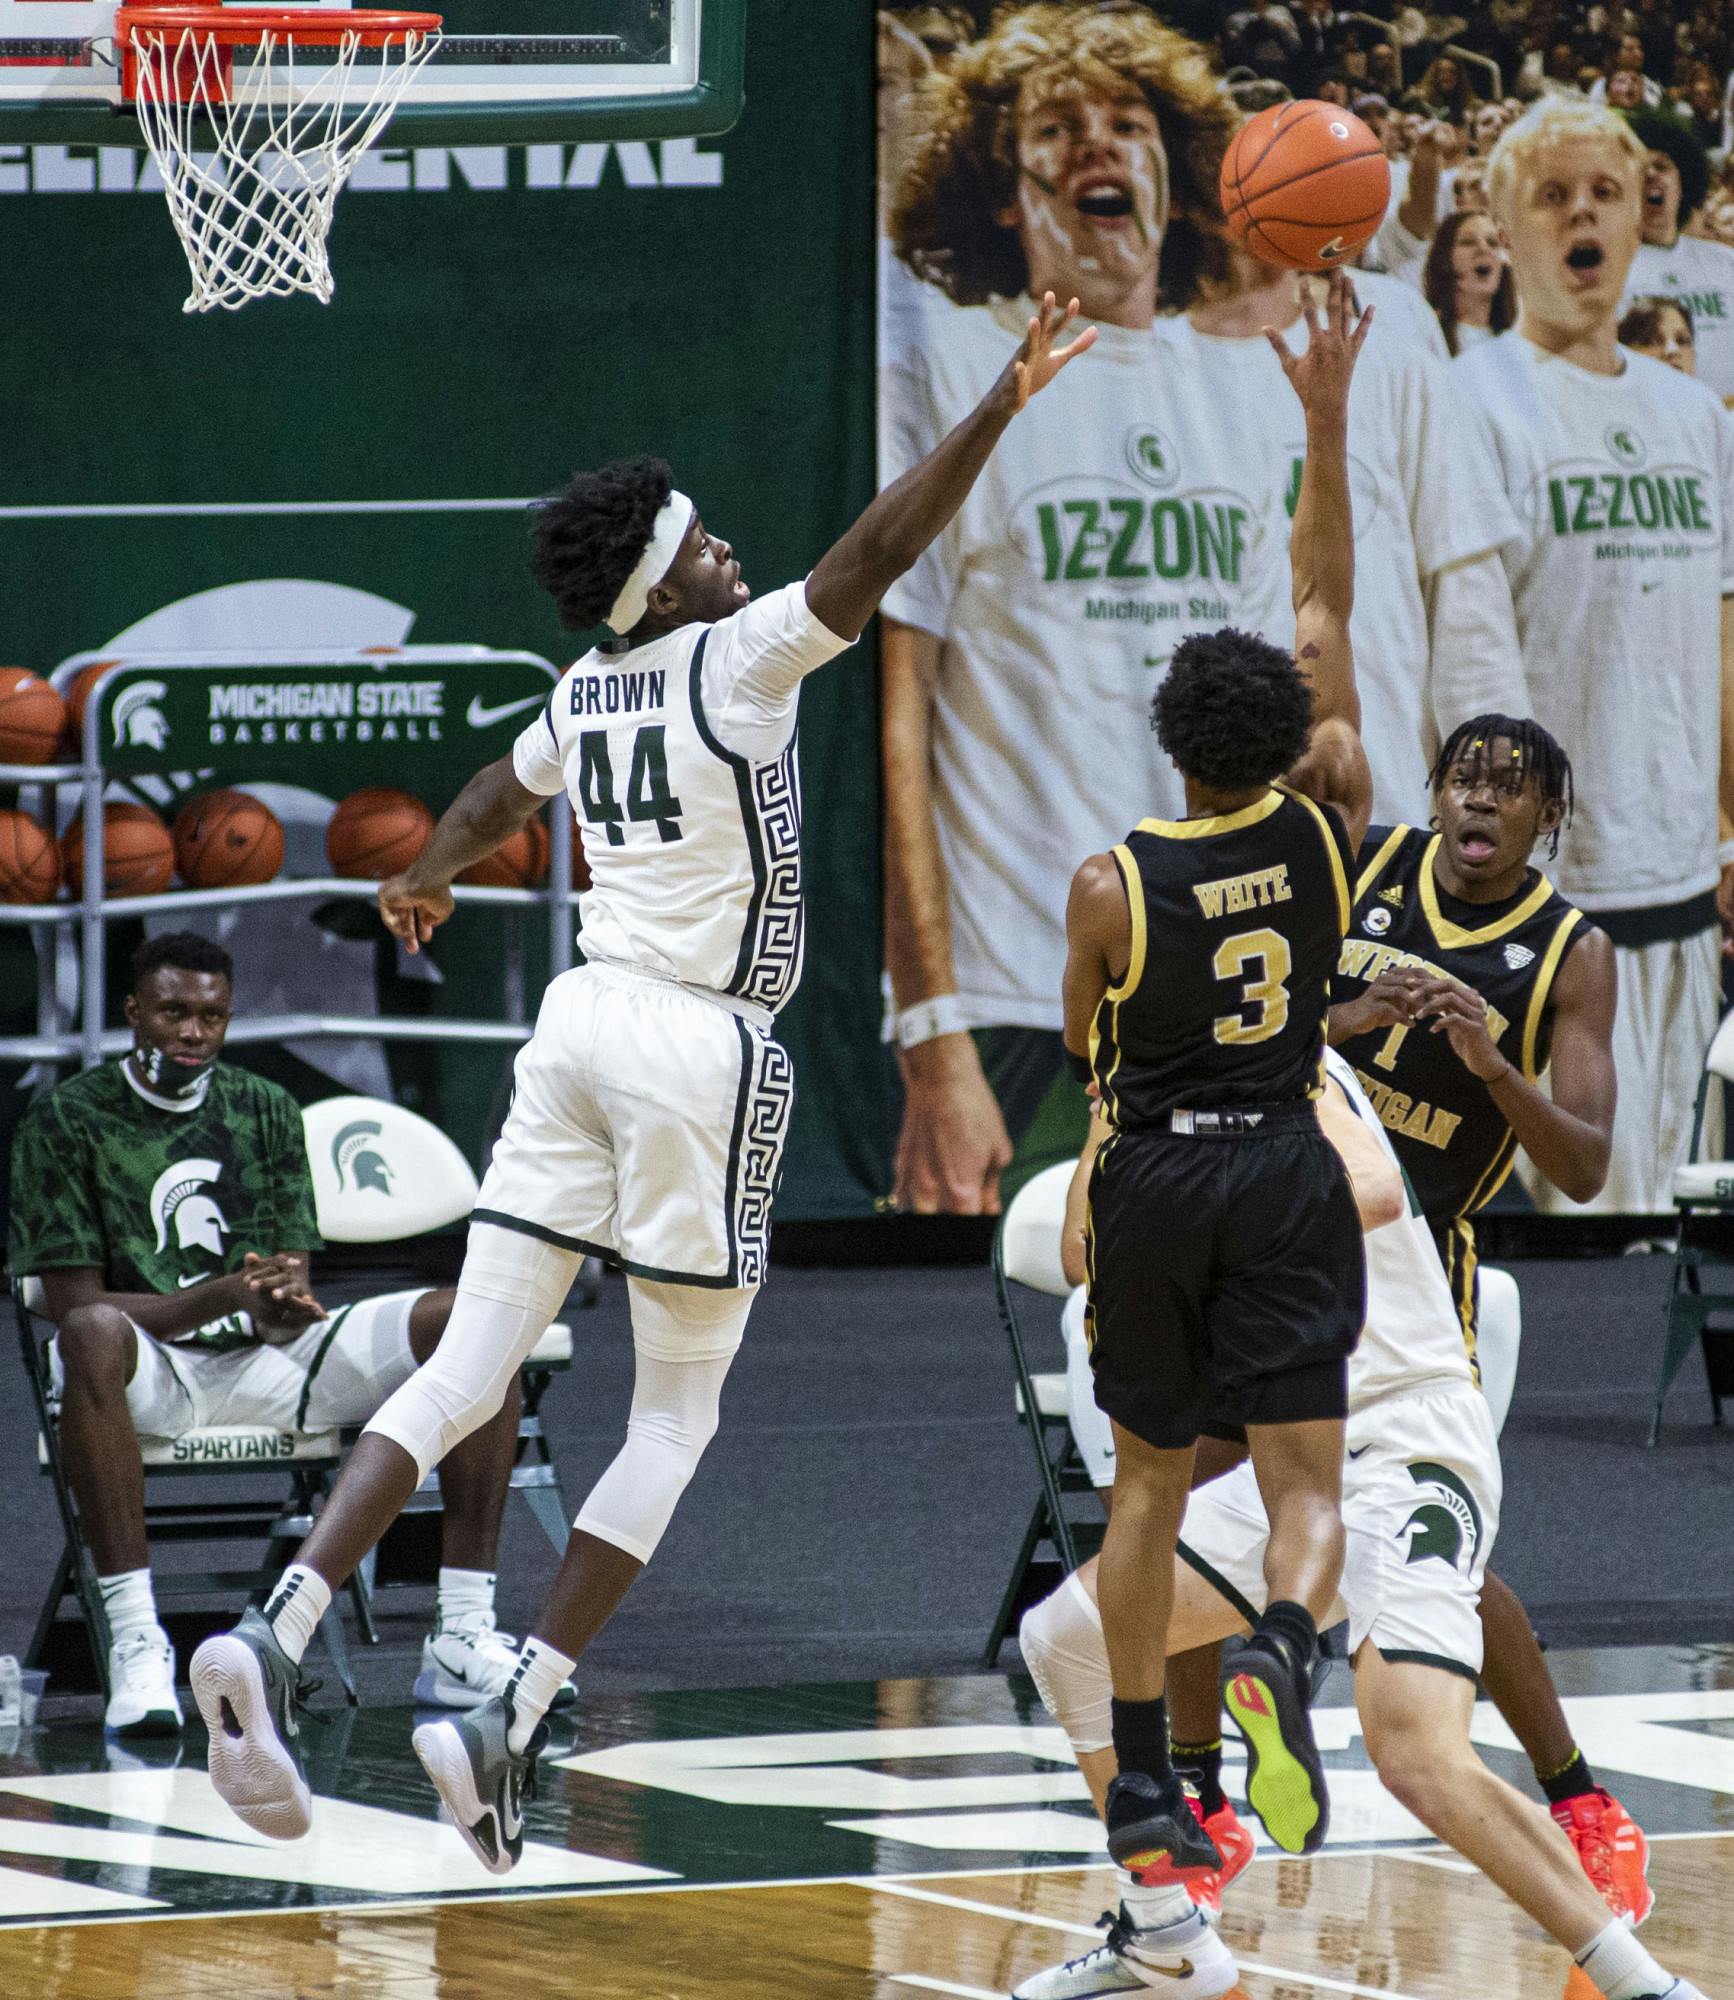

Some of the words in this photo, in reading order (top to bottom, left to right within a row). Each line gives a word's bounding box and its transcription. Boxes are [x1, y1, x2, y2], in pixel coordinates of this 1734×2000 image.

[1549, 473, 1712, 536] IZZONE
[1085, 597, 1180, 625] Michigan
[208, 684, 353, 720] MICHIGAN
[356, 681, 446, 717] STATE
[570, 669, 666, 716] BROWN
[208, 719, 444, 745] BASKETBALL
[578, 725, 684, 847] 44
[1193, 863, 1293, 920] WHITE
[1213, 927, 1292, 1045] 3
[173, 1433, 296, 1461] SPARTANS
